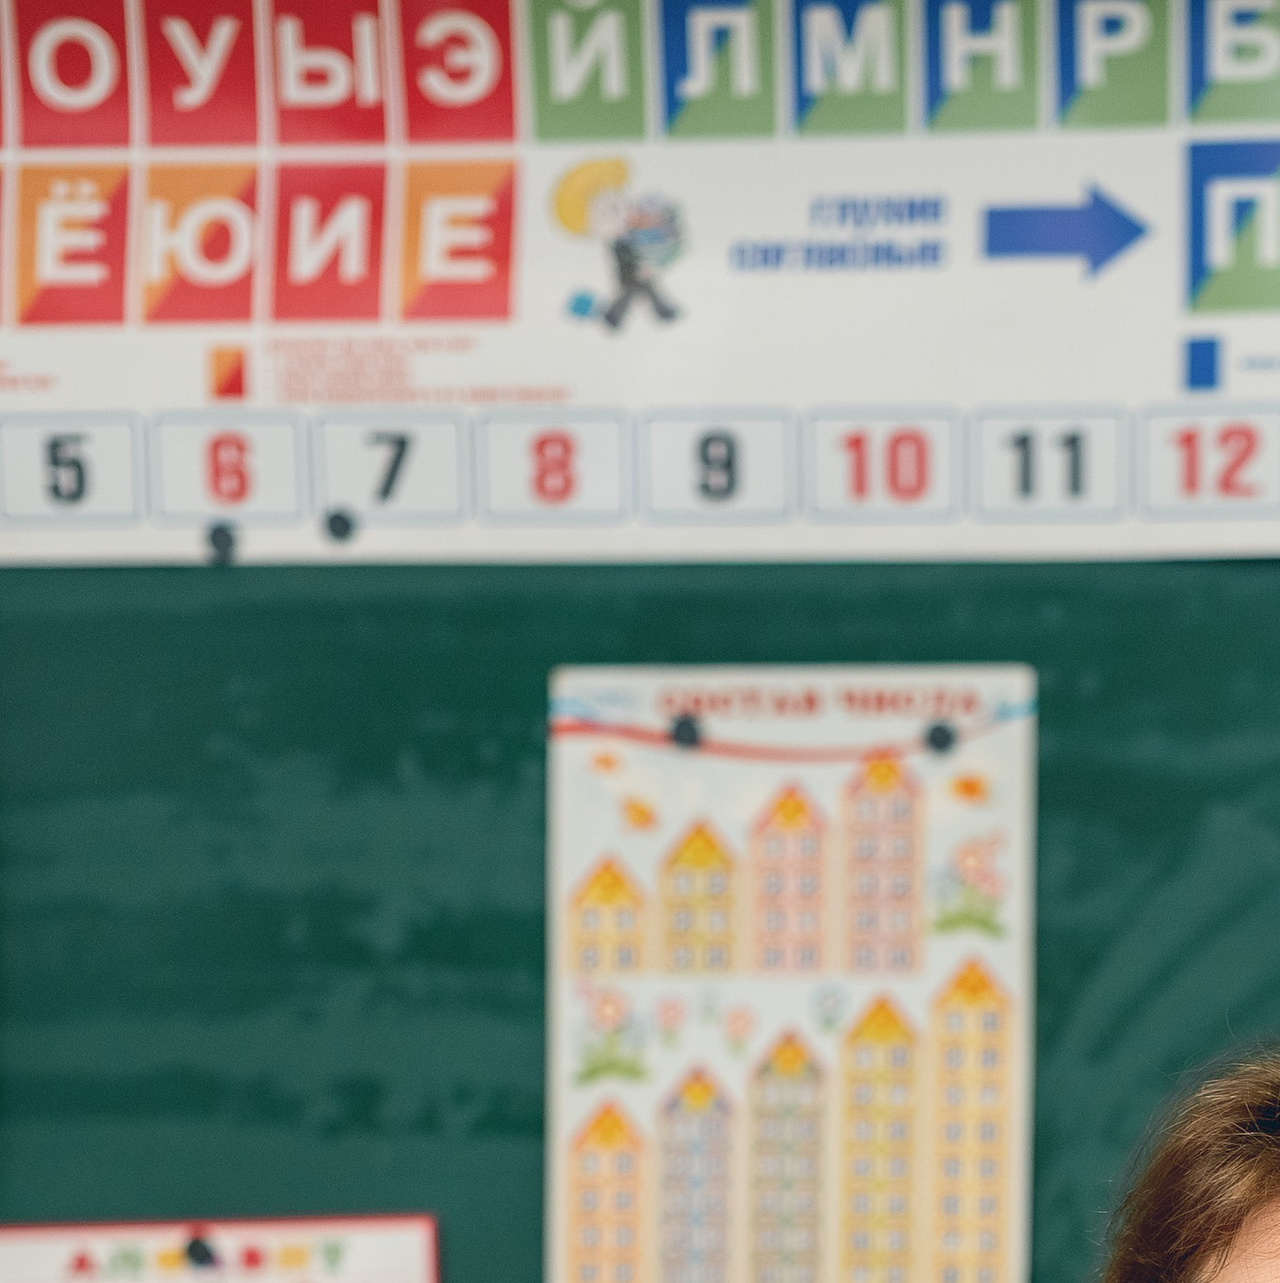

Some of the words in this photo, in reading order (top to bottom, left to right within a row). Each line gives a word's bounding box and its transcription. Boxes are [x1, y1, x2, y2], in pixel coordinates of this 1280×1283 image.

[34, 180, 109, 285] Ё
[147, 199, 256, 287] Ю
[287, 198, 371, 285] И
[421, 198, 495, 283] Е
[45, 432, 87, 504] 5
[207, 430, 250, 506] 6
[367, 430, 410, 503] 7
[530, 429, 576, 504] 8
[697, 429, 738, 501] 9
[842, 429, 931, 500] 10
[1011, 429, 1085, 498] 11
[1173, 424, 1262, 498] 12
